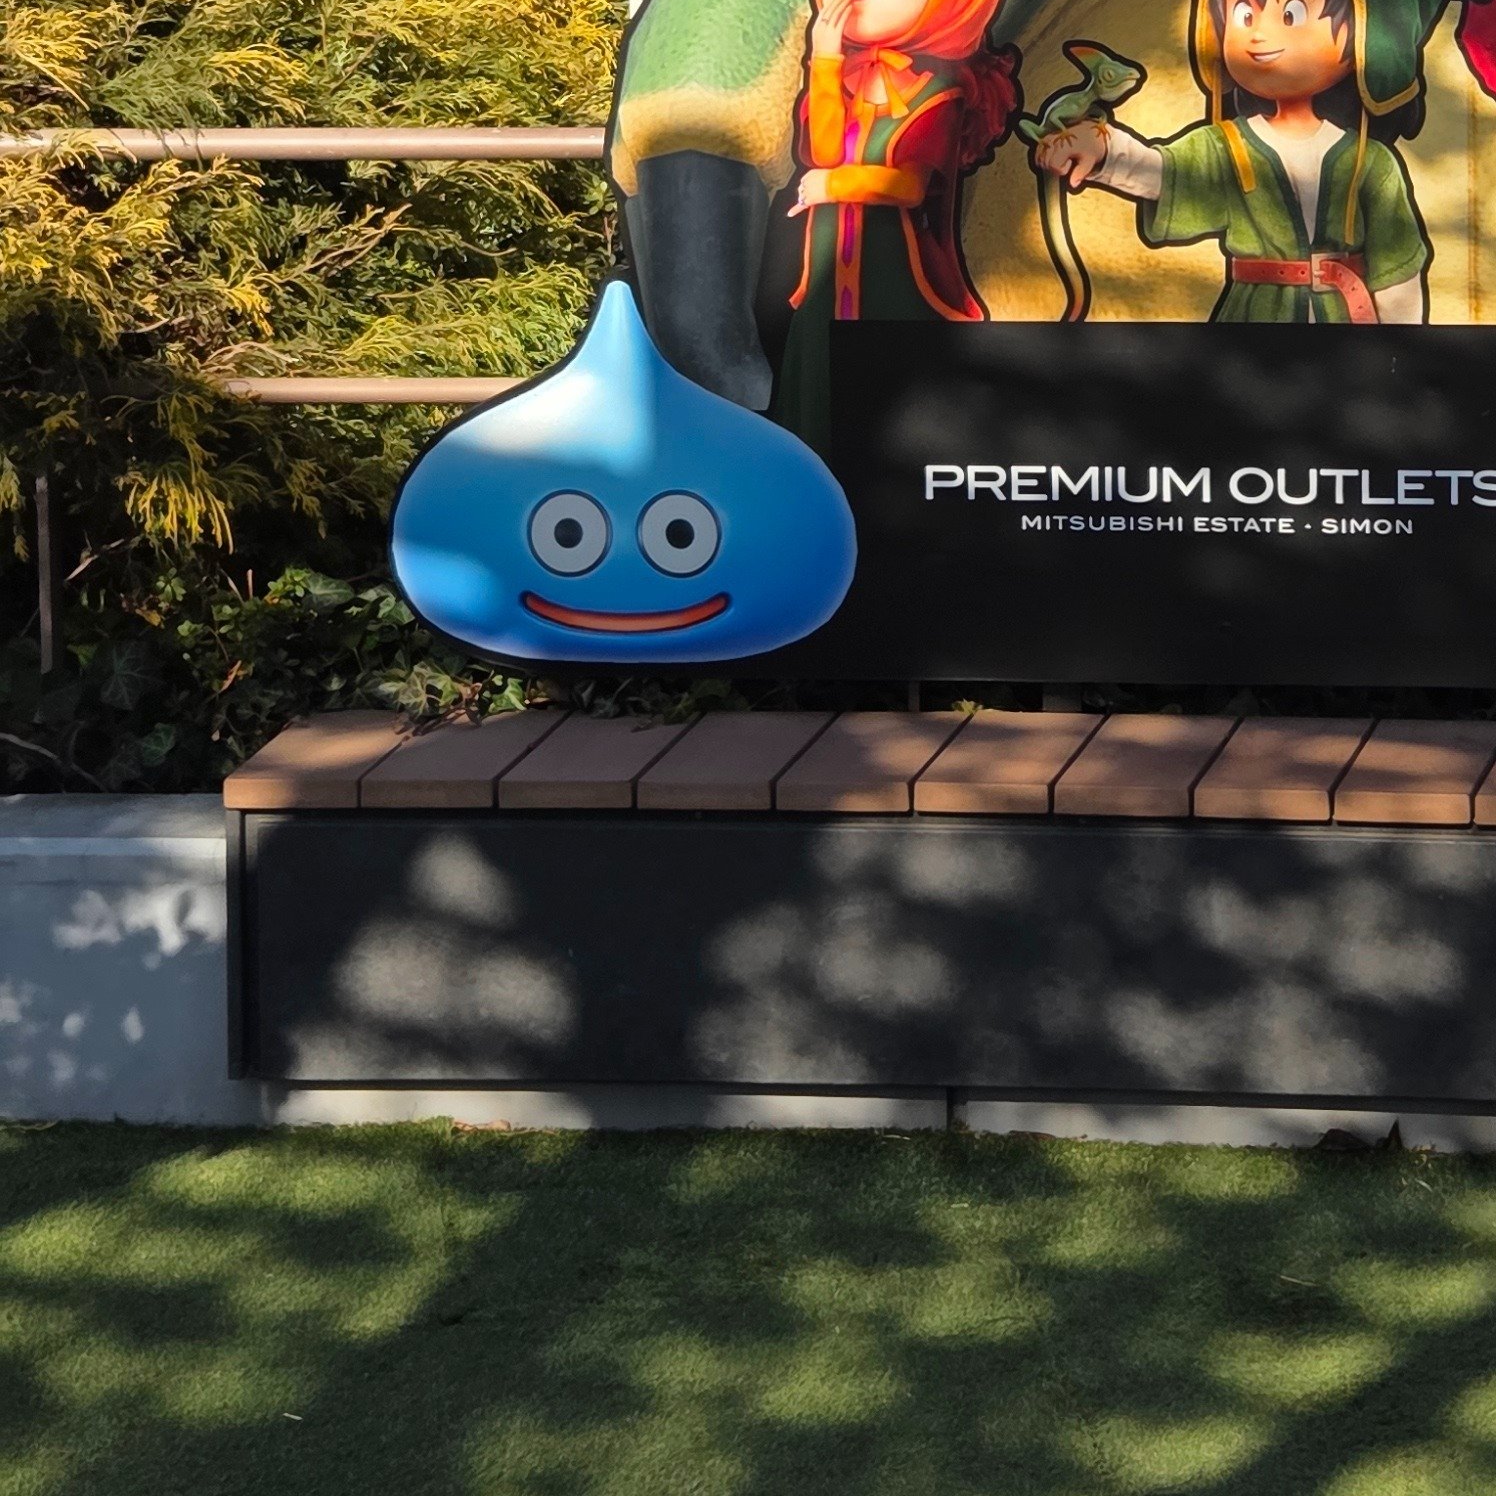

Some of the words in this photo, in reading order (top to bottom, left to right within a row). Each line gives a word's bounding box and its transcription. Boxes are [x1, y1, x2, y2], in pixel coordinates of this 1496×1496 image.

[924, 464, 1212, 504] PREMIUM
[1020, 514, 1184, 532] MITSUBISHI
[1193, 516, 1296, 533] ESTATE
[1320, 517, 1414, 535] SIMON
